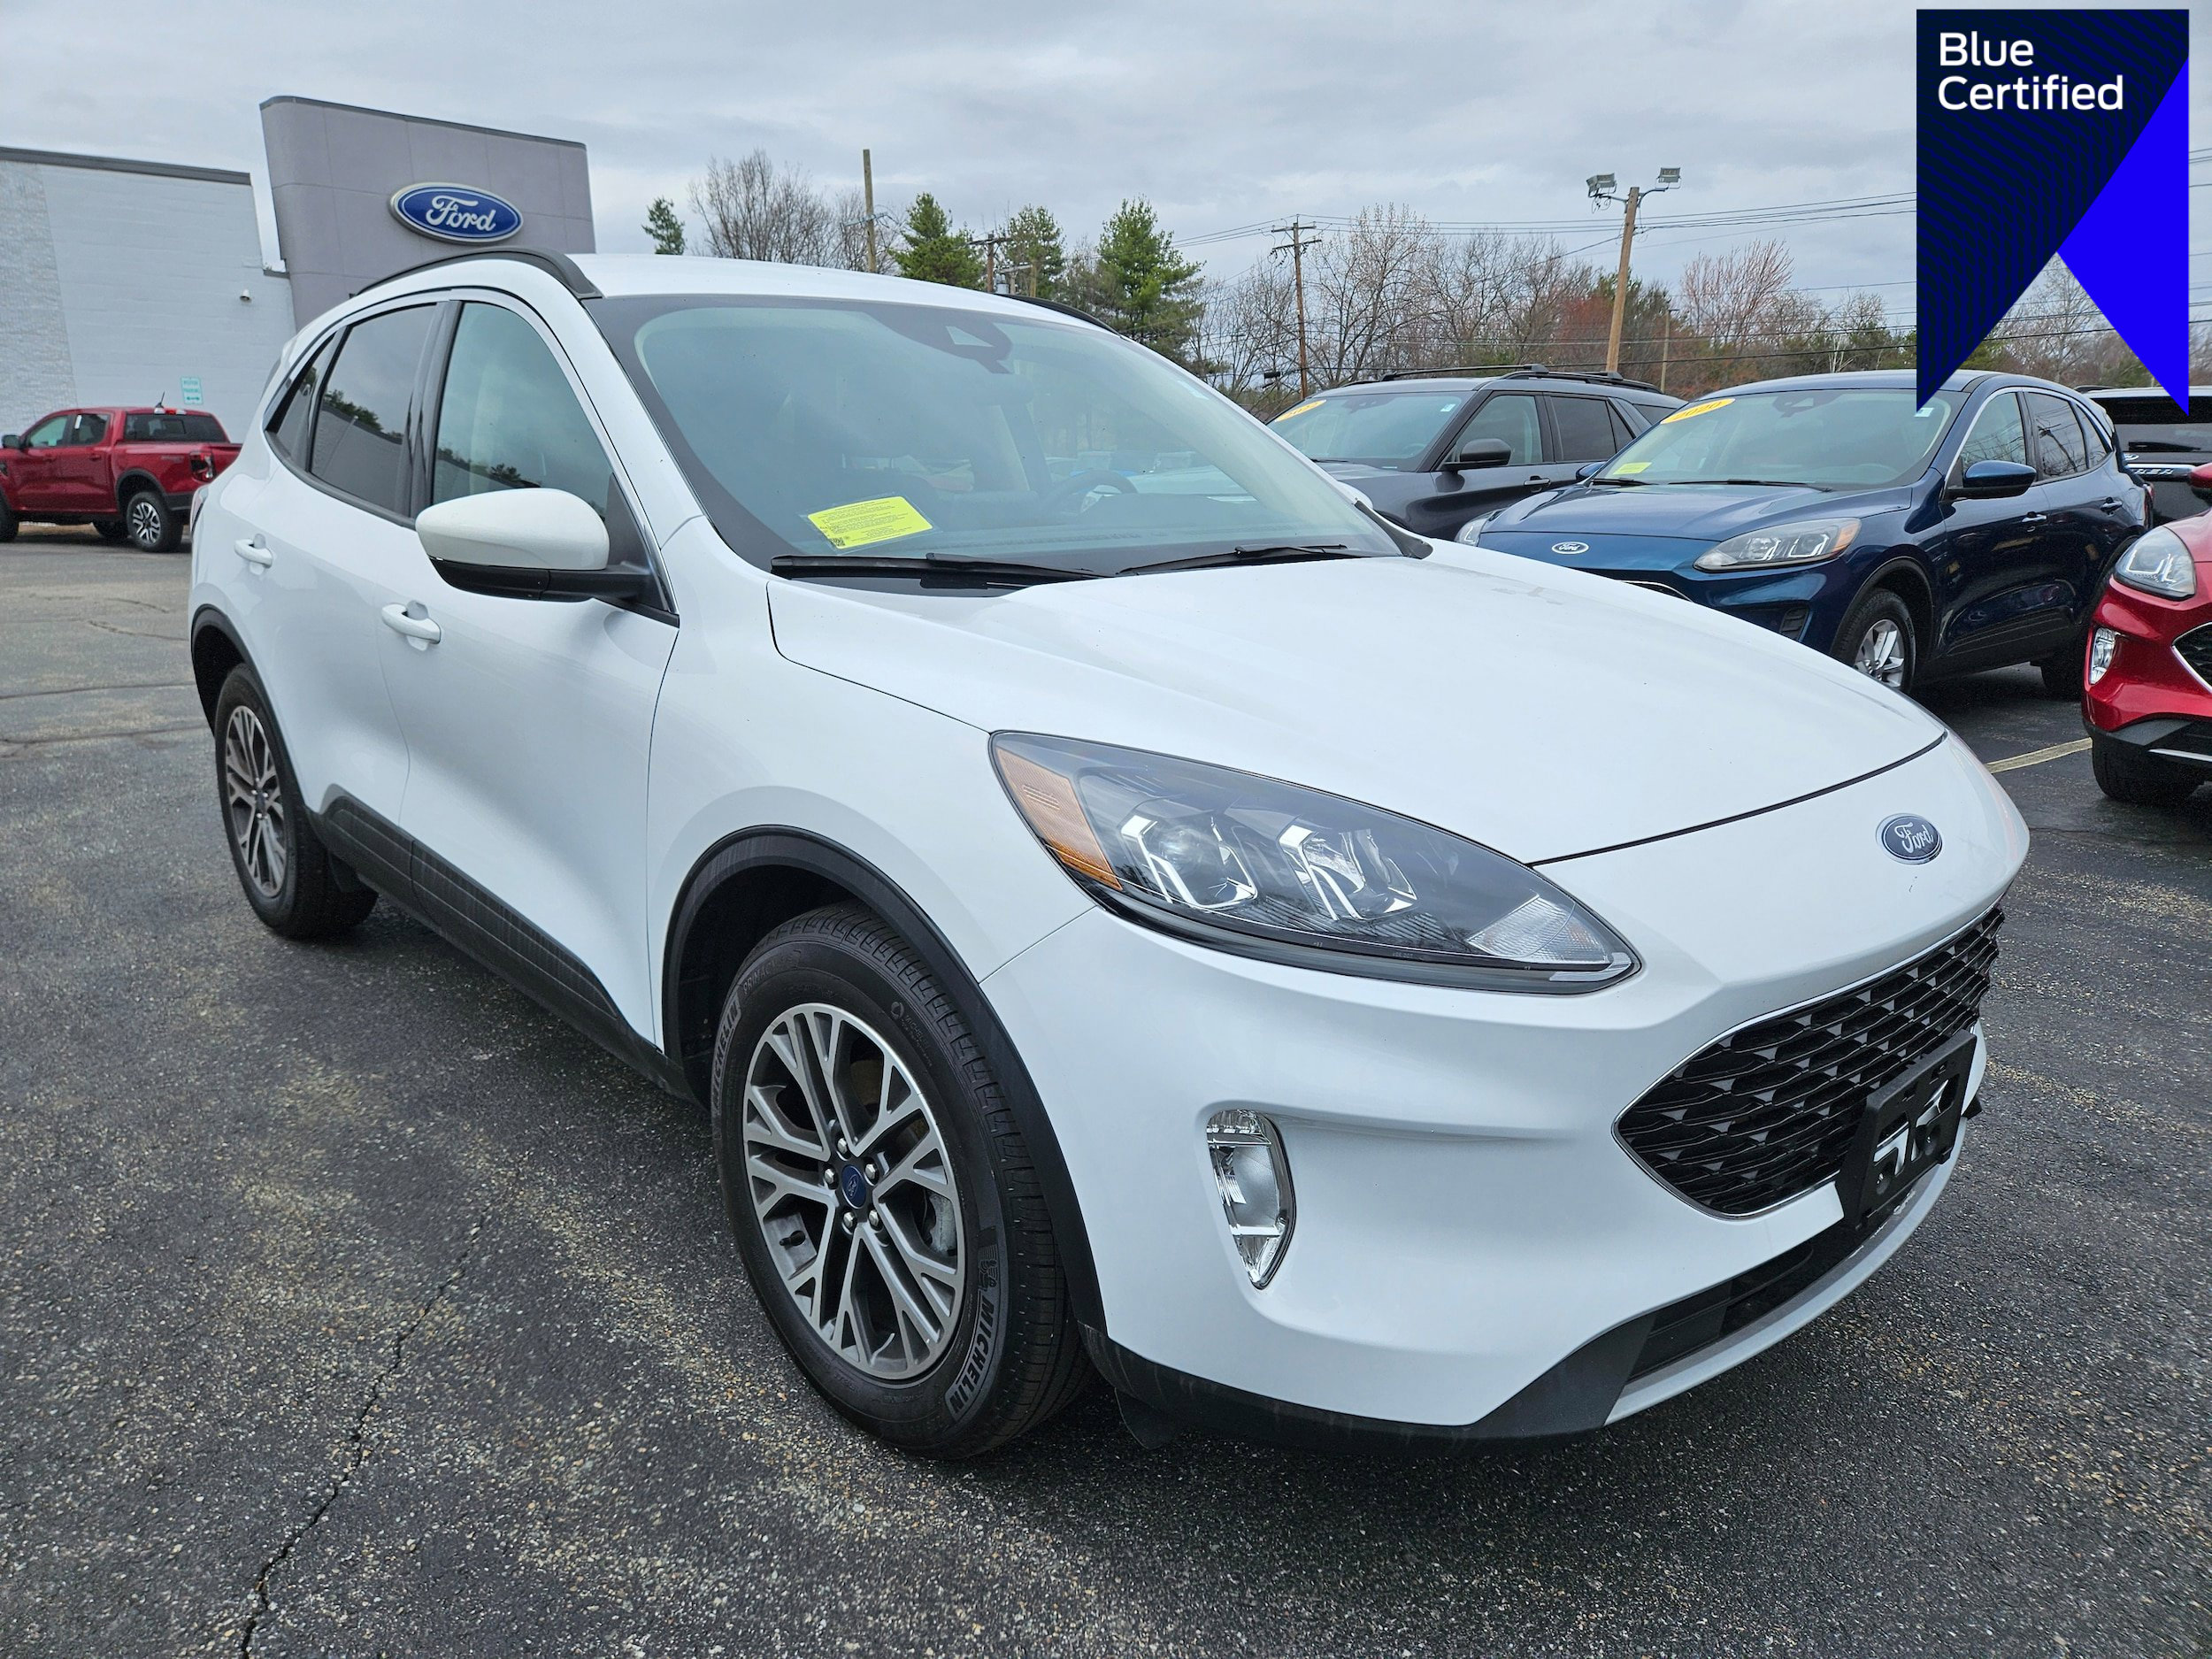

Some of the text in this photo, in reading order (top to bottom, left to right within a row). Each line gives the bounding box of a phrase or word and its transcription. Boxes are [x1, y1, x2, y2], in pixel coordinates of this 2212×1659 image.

[425, 195, 497, 232] Ford
[1893, 821, 1934, 854] Ford
[949, 1294, 995, 1414] MICHELIN
